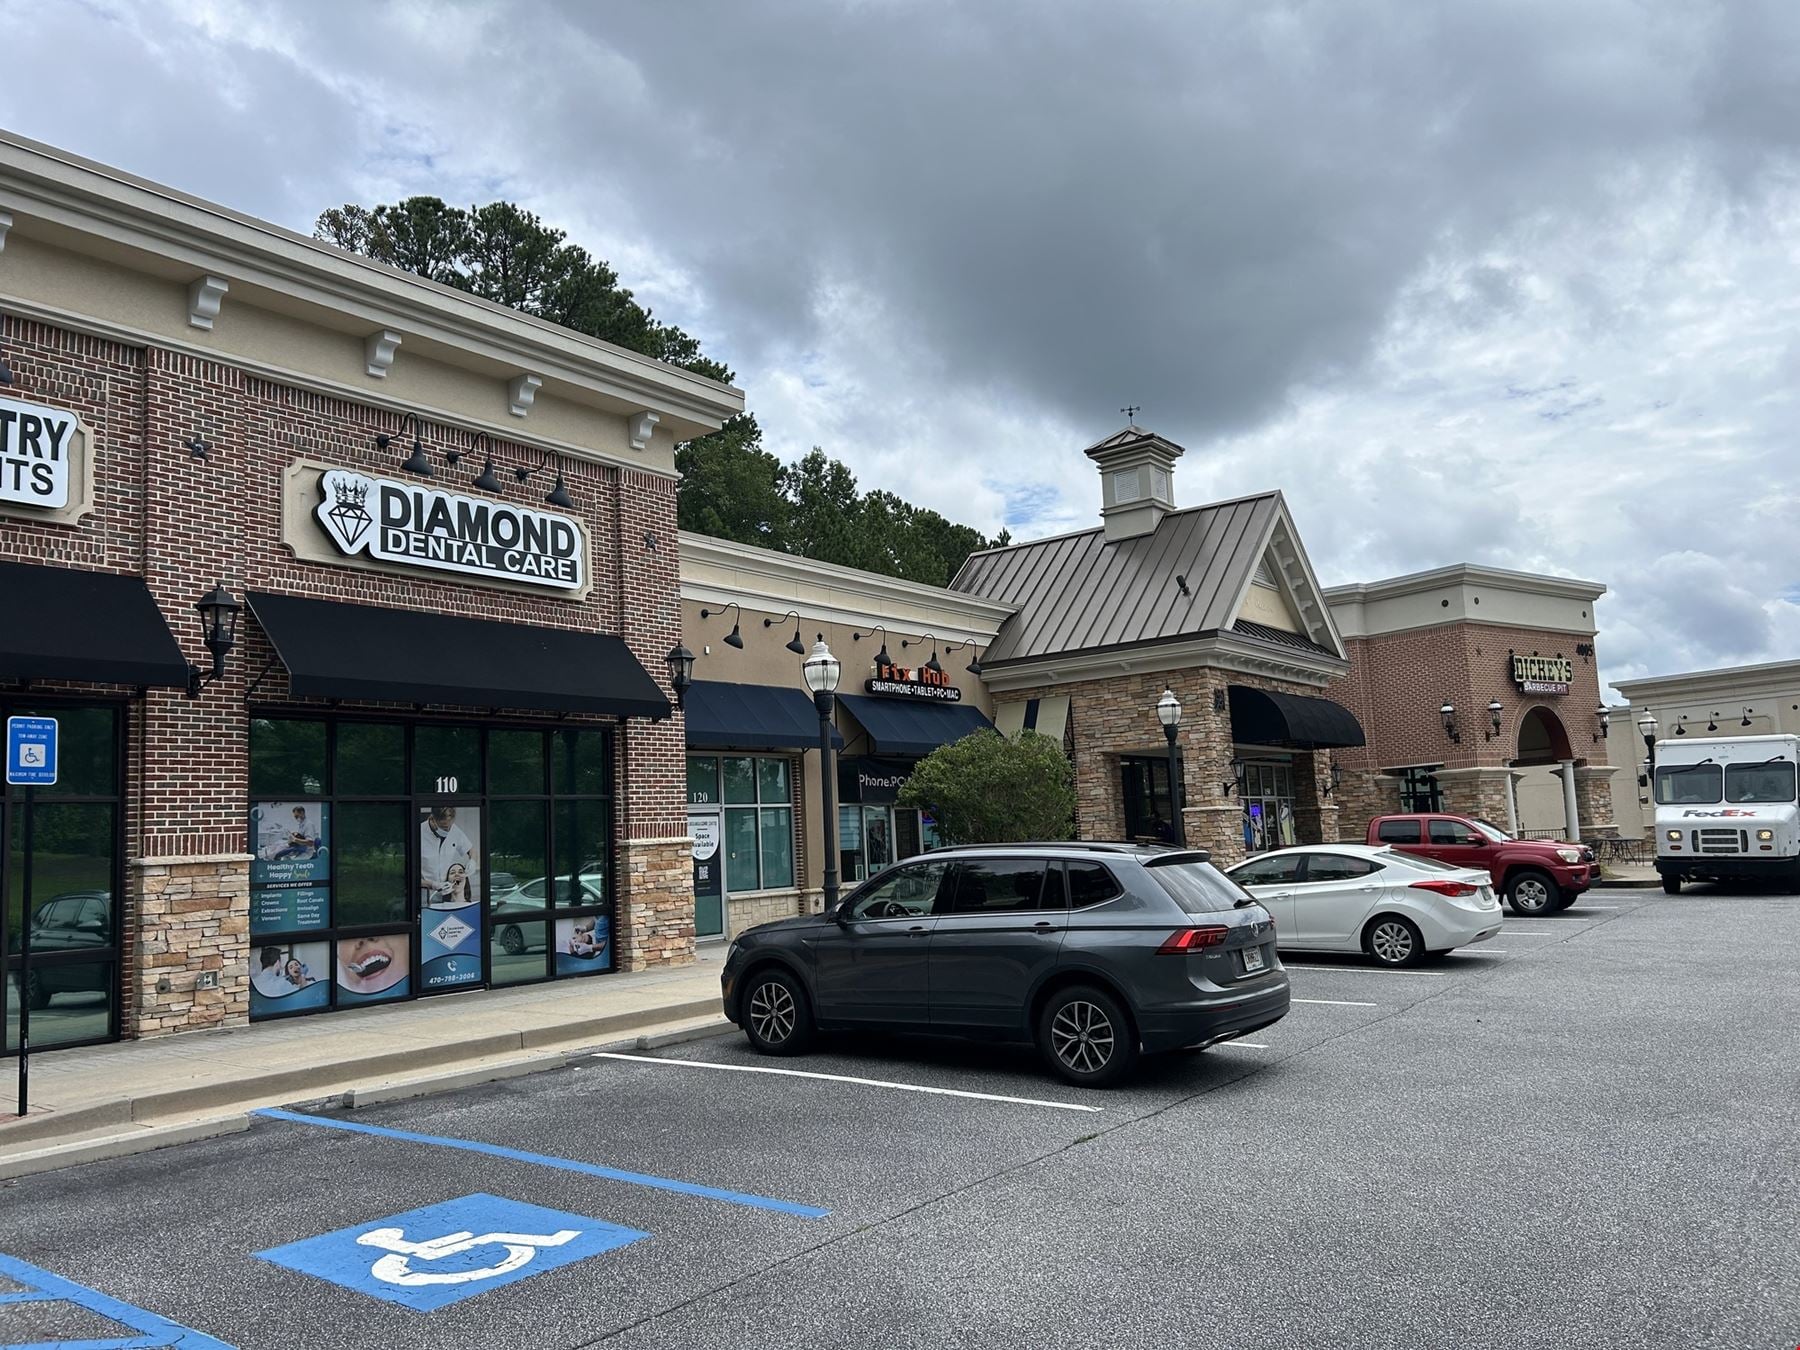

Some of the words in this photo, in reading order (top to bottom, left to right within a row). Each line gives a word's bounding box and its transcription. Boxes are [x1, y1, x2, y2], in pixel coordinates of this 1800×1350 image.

[0, 408, 68, 461] TRY
[0, 456, 53, 496] TS
[380, 485, 575, 558] DIAMOND
[387, 529, 497, 569] DENTAL
[503, 550, 573, 581] CARE
[881, 662, 911, 681] Fix
[922, 666, 950, 686] Hub
[1524, 682, 1556, 692] BARBECUE
[1557, 684, 1567, 692] PIT
[436, 776, 458, 793] 110
[693, 791, 708, 803] 120
[1683, 809, 1757, 818] FedEx
[695, 832, 710, 840] Space
[269, 871, 292, 879] Happy
